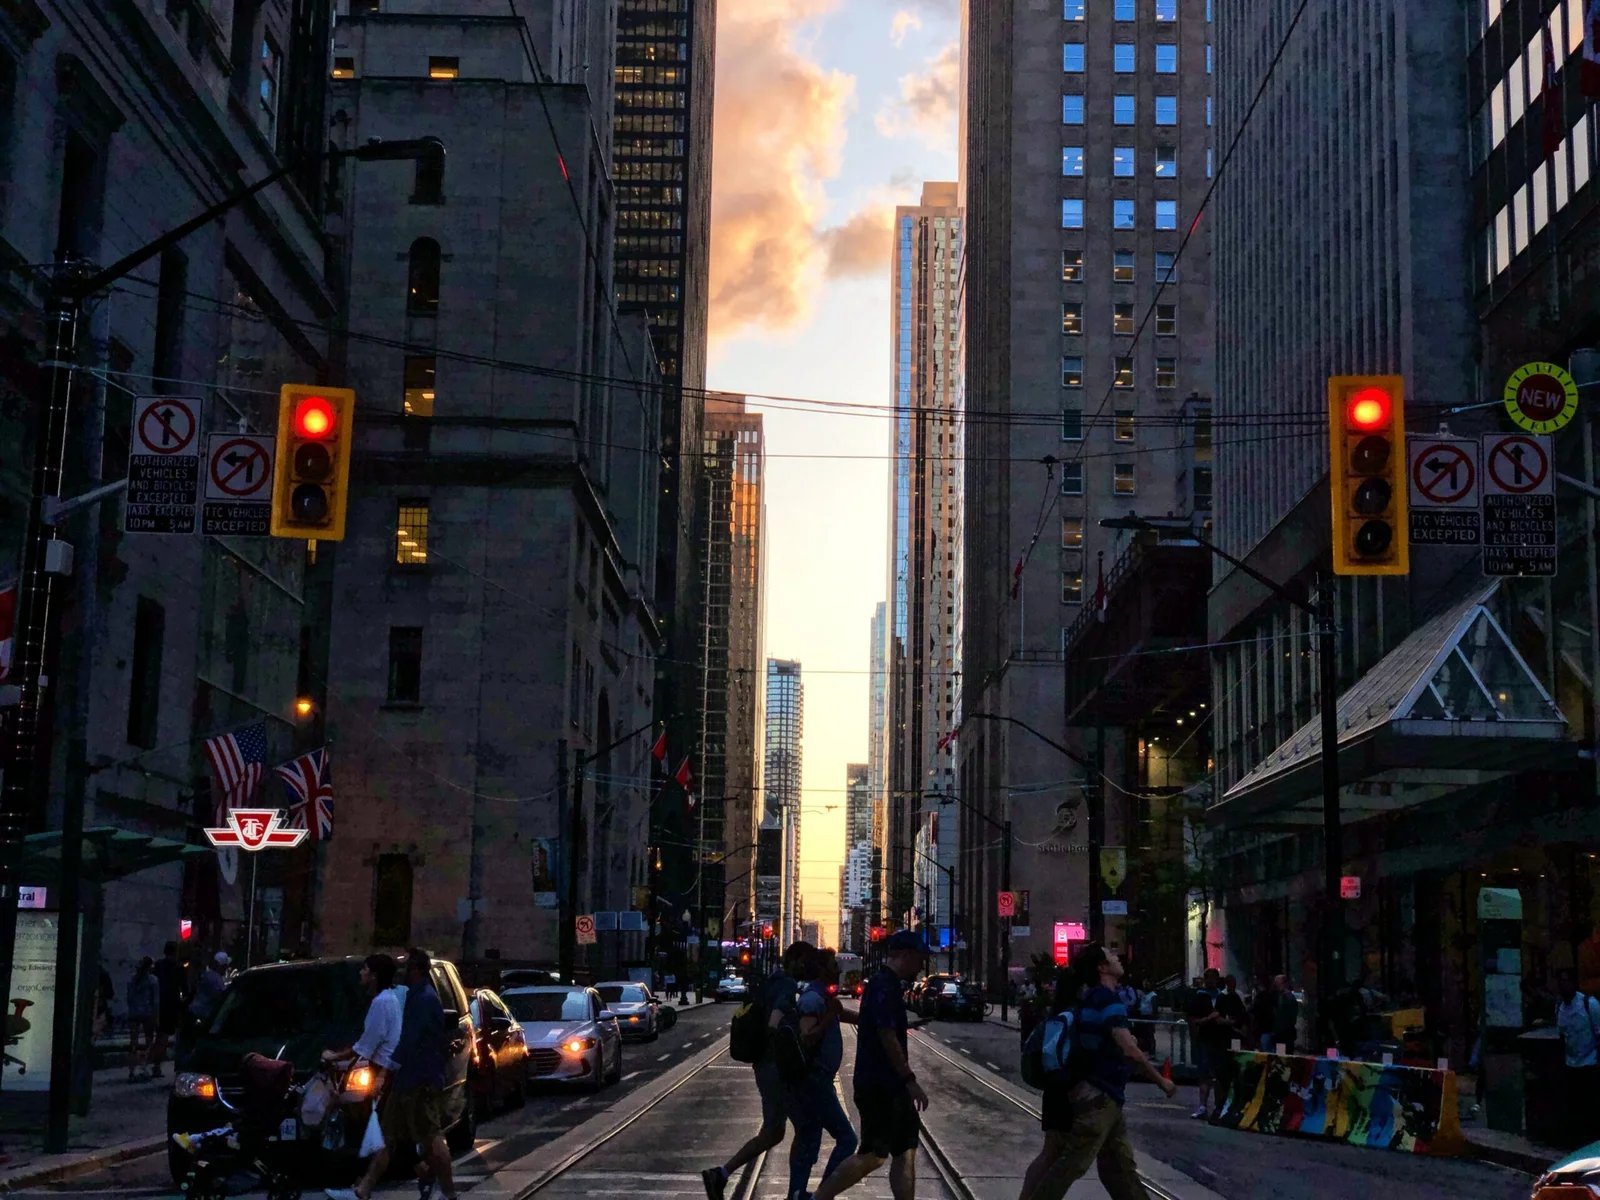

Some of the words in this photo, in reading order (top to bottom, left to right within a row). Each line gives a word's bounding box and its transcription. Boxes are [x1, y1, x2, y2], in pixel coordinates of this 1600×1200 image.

[1520, 387, 1561, 411] NEW
[133, 455, 196, 467] AUTHORIZED
[140, 467, 188, 479] VEHICLES
[130, 479, 149, 491] AND
[154, 480, 196, 492] BICYCLES
[136, 492, 187, 503] EXCEPTED
[1487, 495, 1553, 507] AUTHORIZED
[127, 504, 150, 516] TAXIS
[155, 505, 195, 517] EXCEPTED
[205, 506, 224, 518] TTC
[227, 506, 271, 519] VEHICLES
[1494, 507, 1545, 519] VEHICLES
[207, 519, 267, 532] EXCEPTED
[1411, 514, 1430, 527] TTC
[1433, 514, 1480, 527] VEHICLES
[1487, 520, 1506, 531] AND
[1510, 520, 1554, 532] BICYCLES
[1413, 528, 1476, 541] EXCEPTED
[1493, 533, 1547, 545] EXCEPTED
[1485, 547, 1509, 559] TAXIS
[1513, 547, 1555, 559] EXCEPTED
[240, 818, 264, 840] TTC
[1038, 842, 1089, 854] Scotiaban
